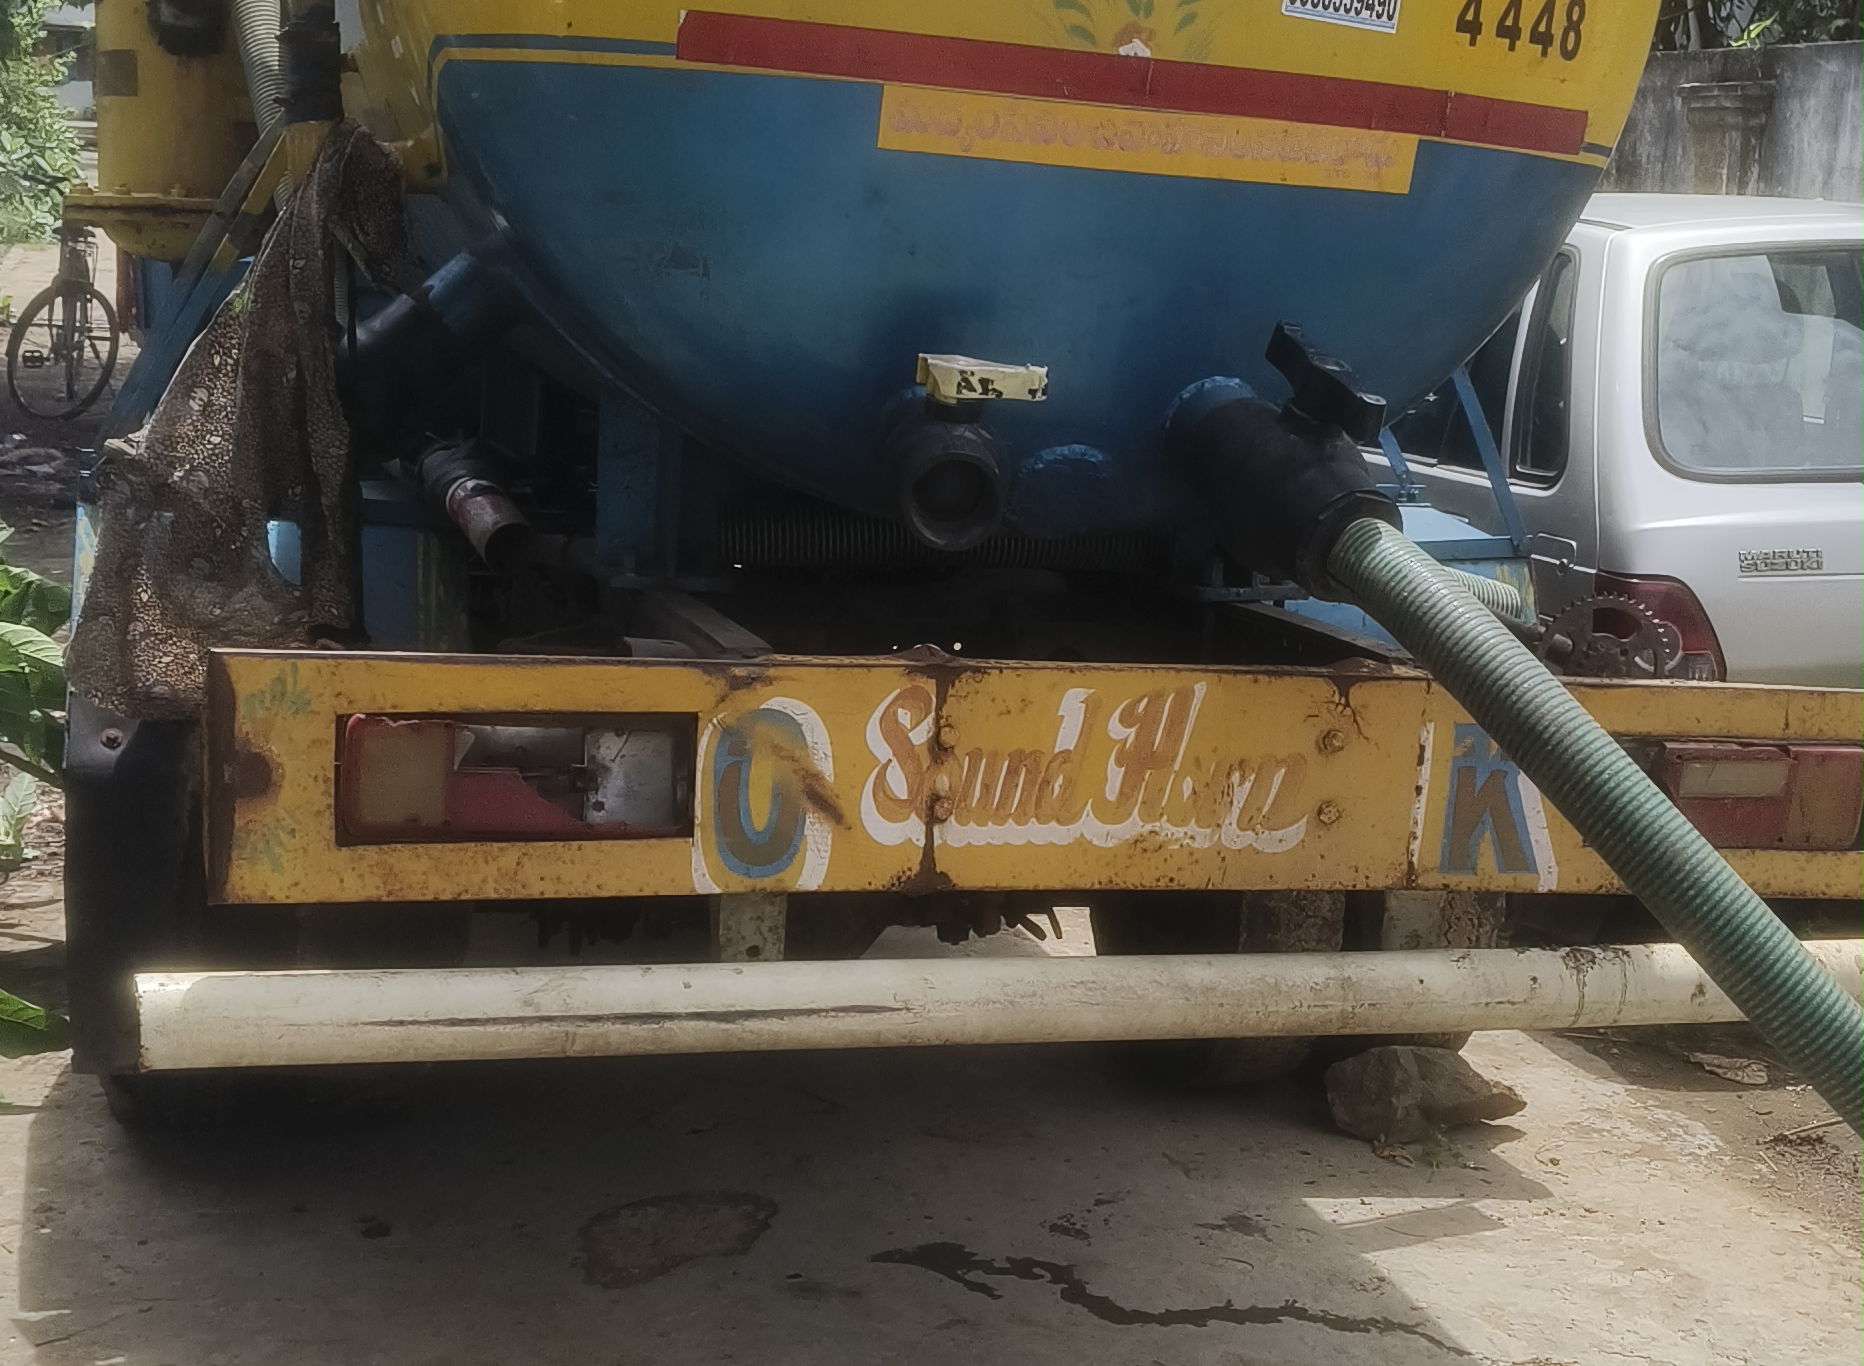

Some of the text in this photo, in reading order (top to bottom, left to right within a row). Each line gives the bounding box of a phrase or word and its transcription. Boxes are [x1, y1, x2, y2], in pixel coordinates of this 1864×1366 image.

[1739, 548, 1823, 561] MARUTI
[1740, 558, 1823, 572] SUZUKI
[861, 685, 1098, 847] Sound
[1088, 681, 1308, 852] Horn
